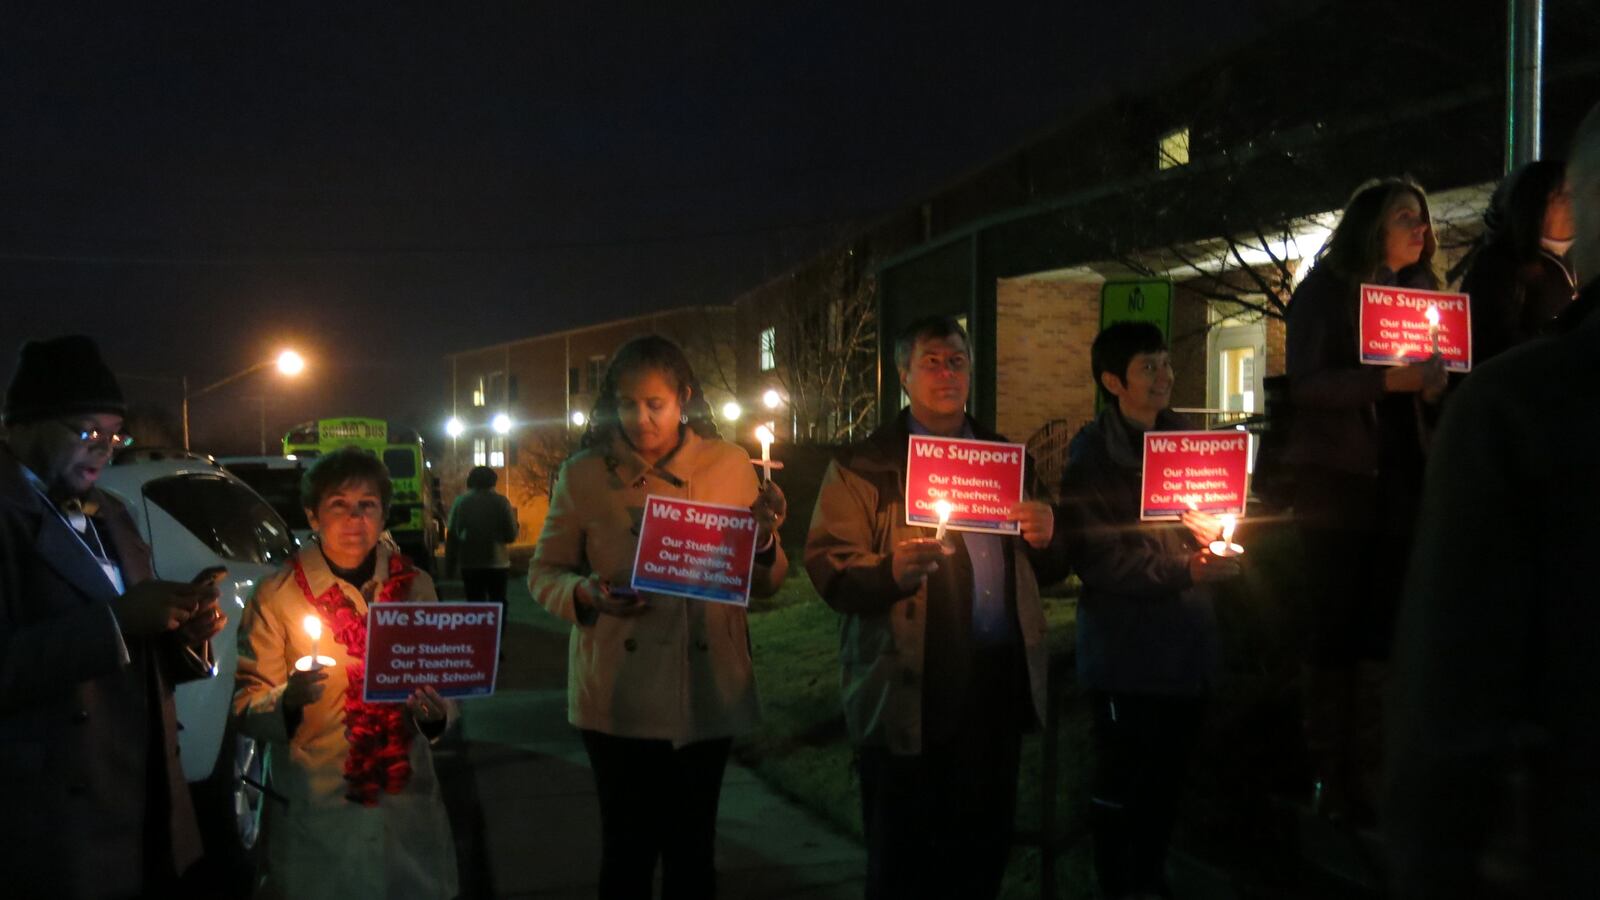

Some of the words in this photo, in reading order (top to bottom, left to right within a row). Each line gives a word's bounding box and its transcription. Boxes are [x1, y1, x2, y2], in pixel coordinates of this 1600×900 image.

[1128, 289, 1145, 313] NO
[1366, 290, 1393, 306] We
[1396, 293, 1464, 312] Support
[1380, 318, 1399, 329] Our
[1380, 330, 1399, 340] Our
[1369, 340, 1390, 350] Our
[322, 424, 360, 438] SCHOOL
[364, 424, 385, 438] BUS
[1150, 438, 1177, 453] We
[1180, 437, 1244, 456] Support
[915, 442, 944, 458] We
[948, 444, 1018, 466] Support
[1163, 467, 1183, 478] Our
[1185, 467, 1229, 478] Students,
[928, 473, 948, 485] Our
[952, 474, 1001, 489] Students,
[1163, 480, 1182, 491] Our
[1185, 480, 1228, 491] Teachers,
[928, 487, 948, 498] Our
[951, 488, 1000, 502] Teachers,
[1150, 494, 1170, 503] Our
[1204, 492, 1238, 502] Schools
[971, 503, 1010, 515] Schools
[652, 502, 681, 520] We
[684, 508, 754, 531] Support
[661, 536, 683, 548] Our
[685, 539, 735, 557] Students,
[659, 550, 680, 561] Our
[683, 553, 732, 571] Teachers,
[644, 562, 666, 574] Our
[668, 566, 700, 580] Public
[703, 571, 742, 586] Schools
[376, 610, 409, 626] We
[413, 609, 495, 631] Support
[392, 644, 415, 654] Our
[418, 644, 474, 655] Students,
[391, 659, 415, 669] Our
[420, 659, 474, 669] Teachers,
[376, 673, 400, 684] Our
[403, 672, 438, 683] Public
[441, 671, 485, 682] Schools
